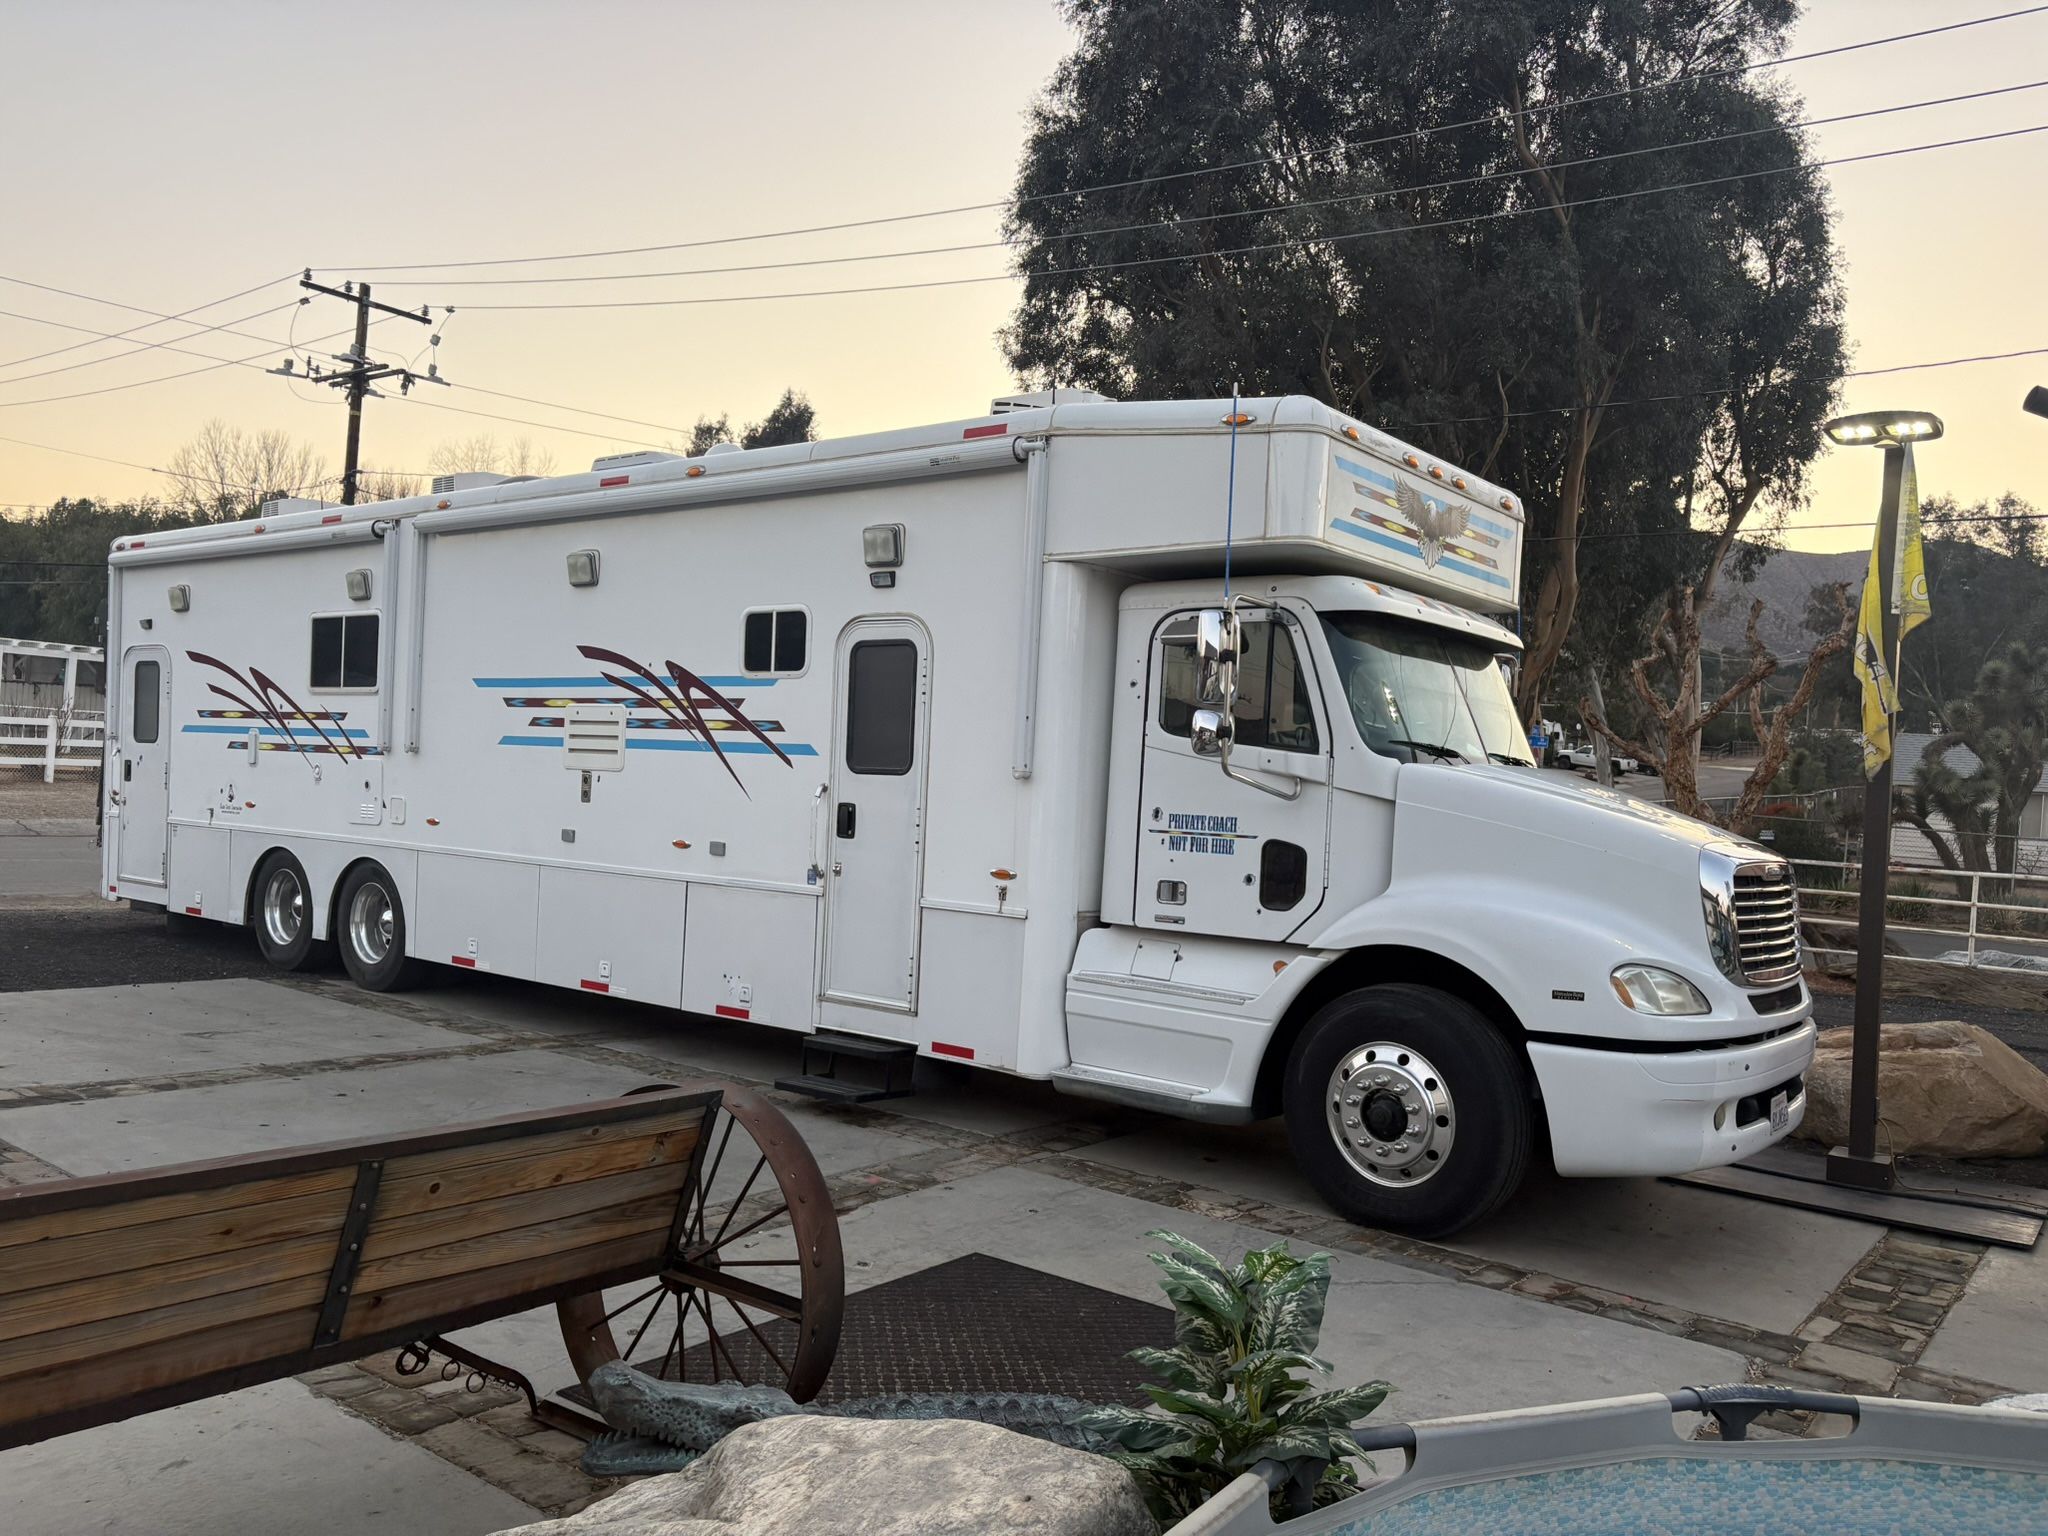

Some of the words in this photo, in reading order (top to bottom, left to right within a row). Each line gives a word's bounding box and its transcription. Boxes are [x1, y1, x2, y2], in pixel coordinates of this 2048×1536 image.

[1168, 813, 1207, 831] PRIVATE
[1207, 815, 1238, 833] COACH
[1168, 835, 1188, 852] NOT
[1189, 836, 1209, 853] FOR
[1211, 838, 1235, 855] HIRE
